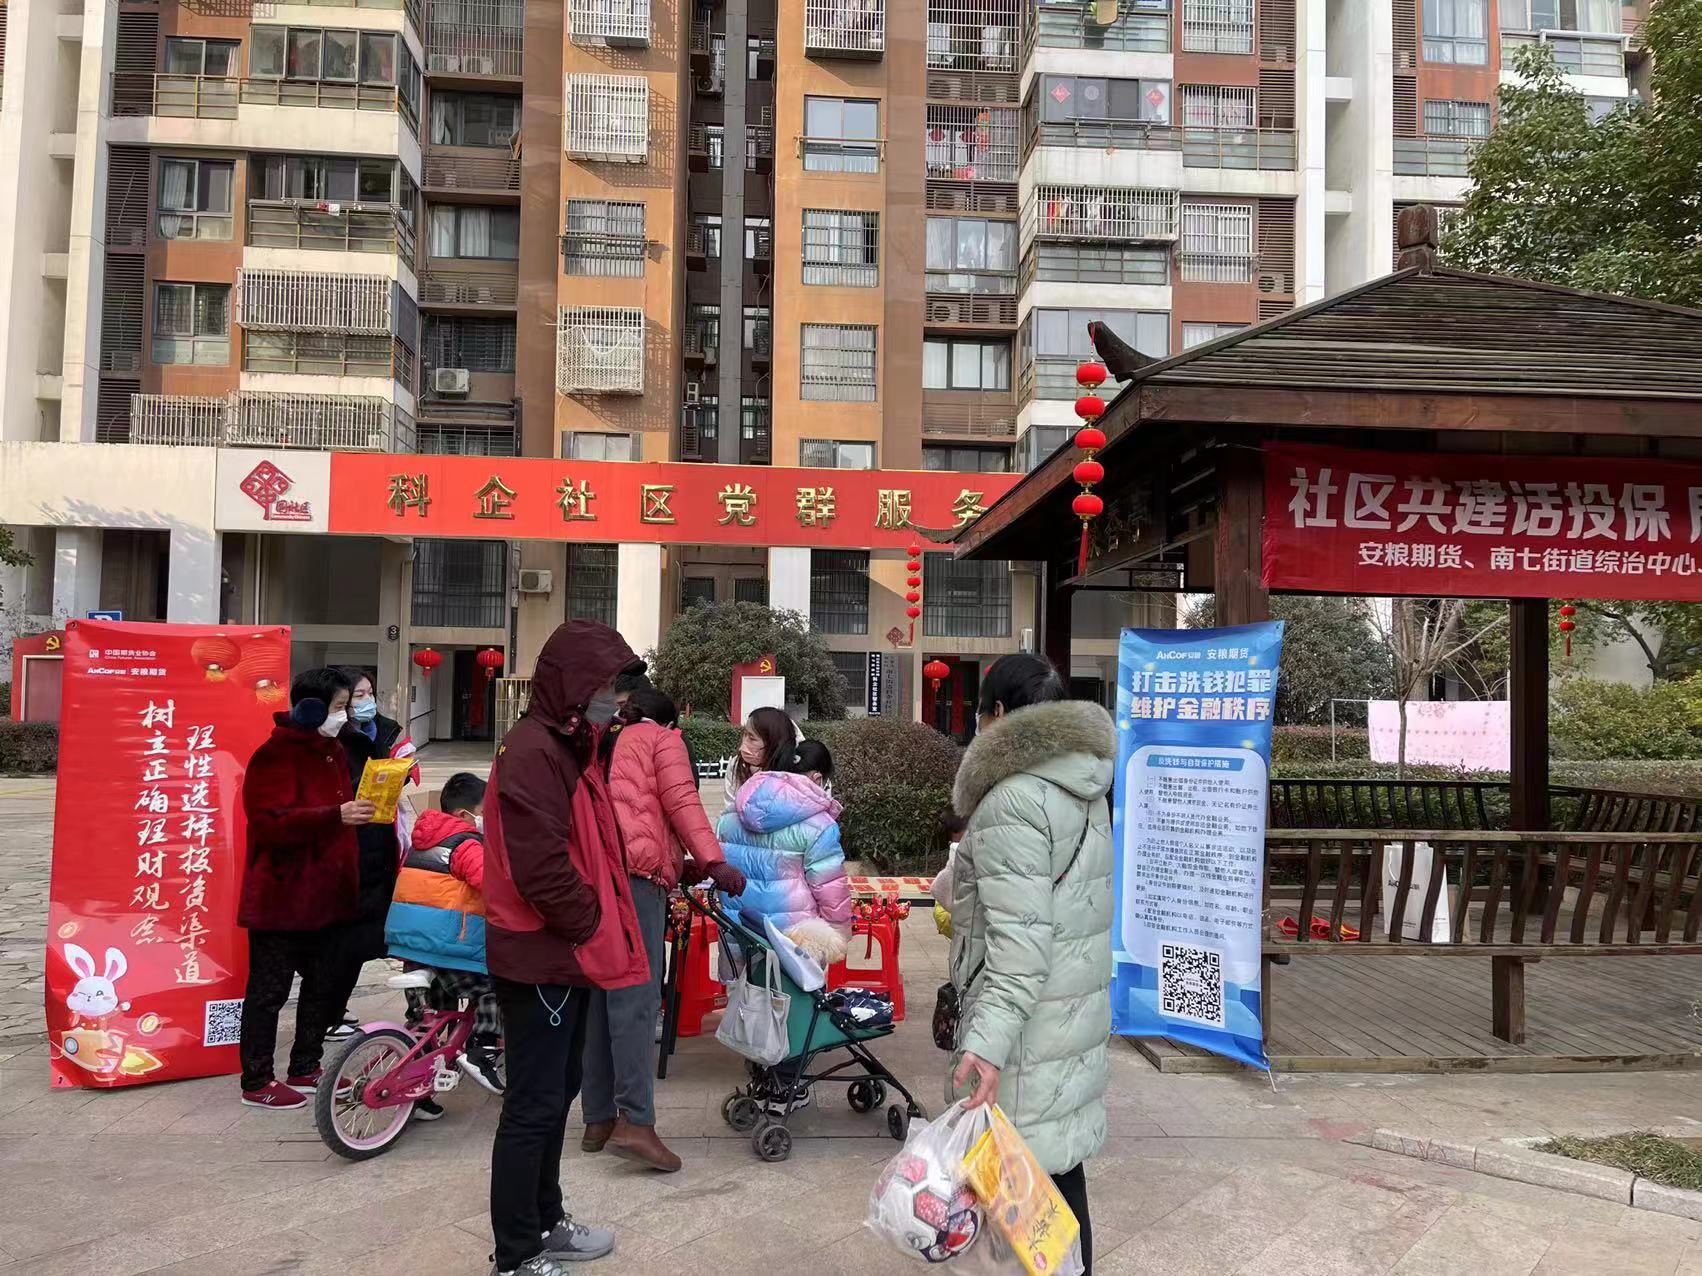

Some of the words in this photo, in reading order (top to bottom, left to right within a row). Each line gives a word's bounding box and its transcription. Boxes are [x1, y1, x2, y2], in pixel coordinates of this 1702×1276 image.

[1288, 467, 1672, 542] 社区共建话投保
[1207, 648, 1249, 660] 安粮期货
[1131, 669, 1271, 693] 打击洗钱犯罪
[1130, 696, 1270, 720] 维护金融秩序
